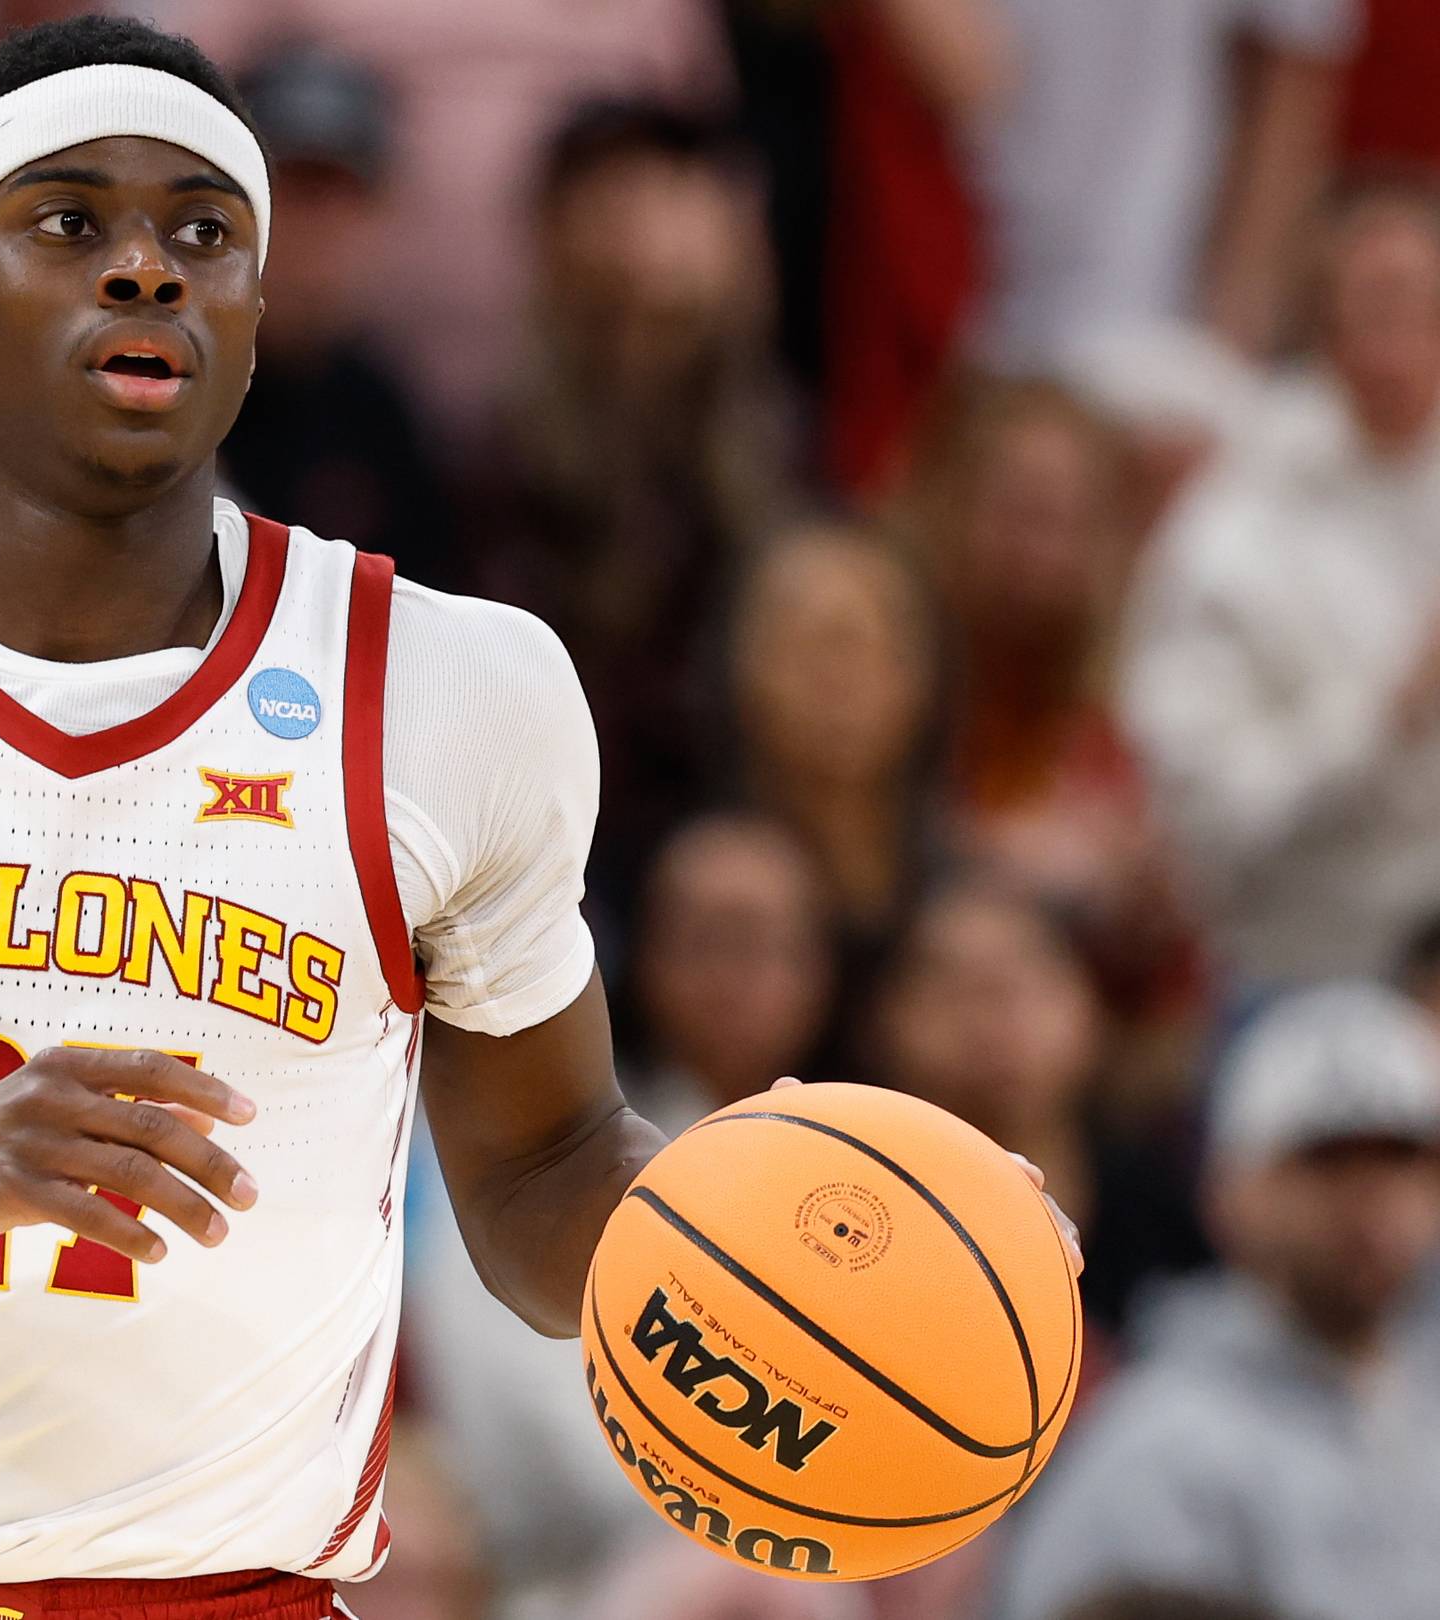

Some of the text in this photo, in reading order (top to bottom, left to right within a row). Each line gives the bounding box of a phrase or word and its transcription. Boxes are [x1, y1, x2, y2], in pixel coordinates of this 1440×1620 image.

[259, 698, 317, 722] NCAA
[201, 770, 290, 823] XII
[630, 1285, 839, 1473] NCAA
[667, 1270, 849, 1420] OFFICIAL GAME BALL
[586, 1351, 839, 1576] Wilson
[639, 1440, 721, 1505] EVO NXT
